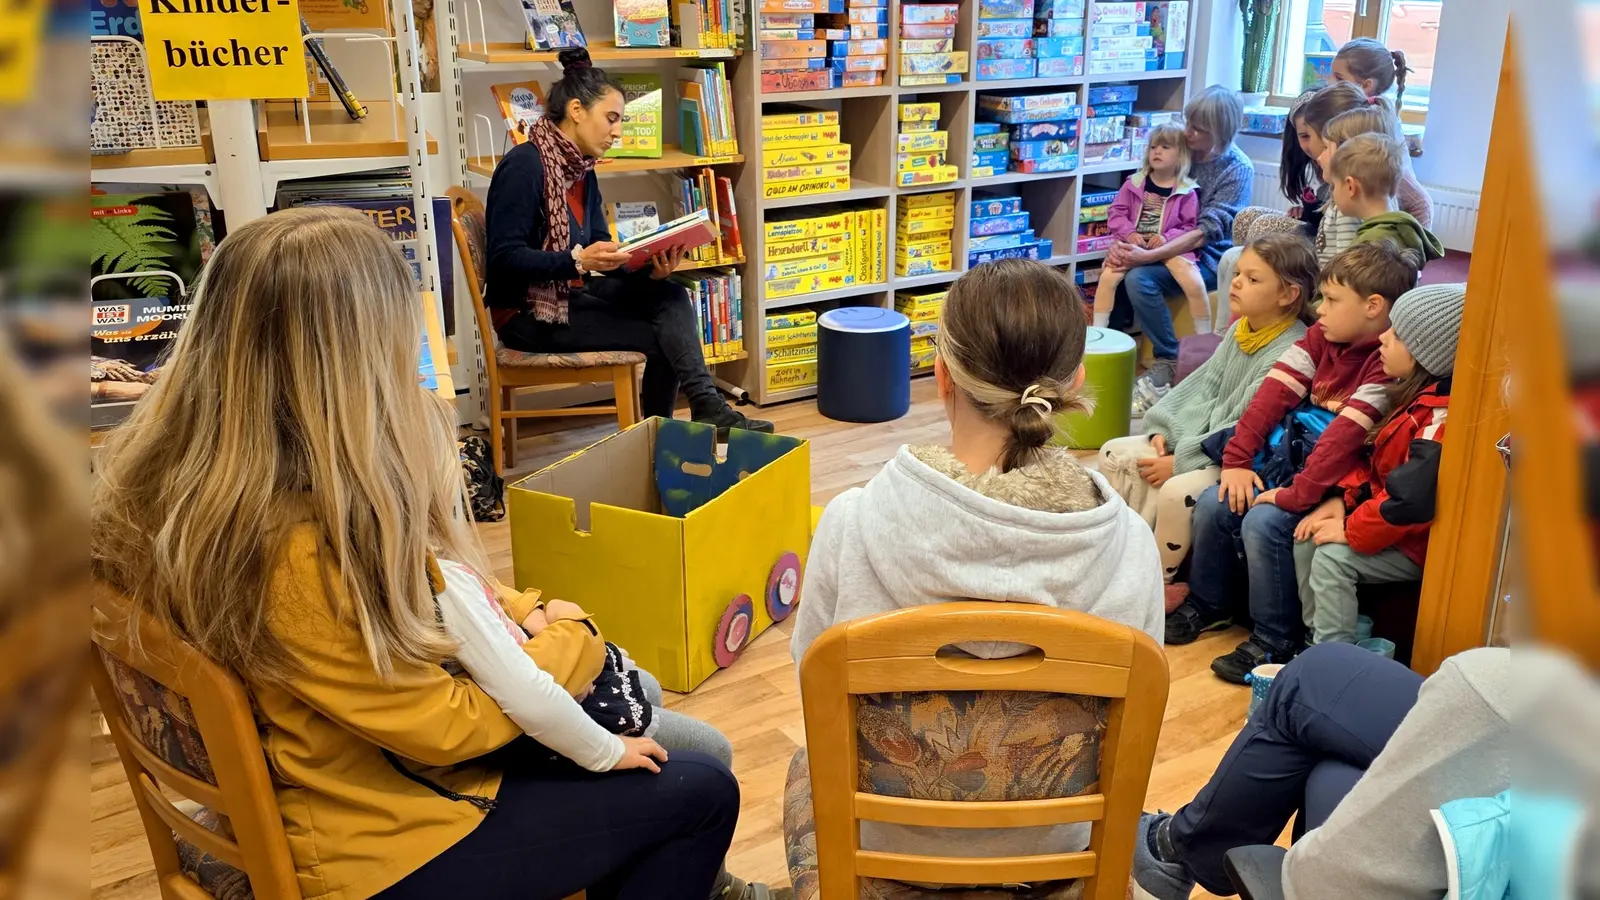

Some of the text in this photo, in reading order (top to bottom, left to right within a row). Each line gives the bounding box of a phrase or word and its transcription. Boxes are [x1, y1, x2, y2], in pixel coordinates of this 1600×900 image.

[91, 10, 142, 36] Erd
[162, 38, 289, 68] bücher
[634, 125, 657, 136] TOD?
[766, 181, 830, 197] GOLD AM ORINOKO
[363, 206, 416, 228] TER
[825, 221, 841, 229] HABA
[768, 241, 809, 257] Hexenduell
[97, 305, 125, 313] WAS
[142, 304, 194, 314] MUMIE
[136, 313, 190, 323] MOORL
[93, 329, 119, 337] Was
[103, 330, 178, 344] uns erzäh
[775, 367, 792, 377] Zoff
